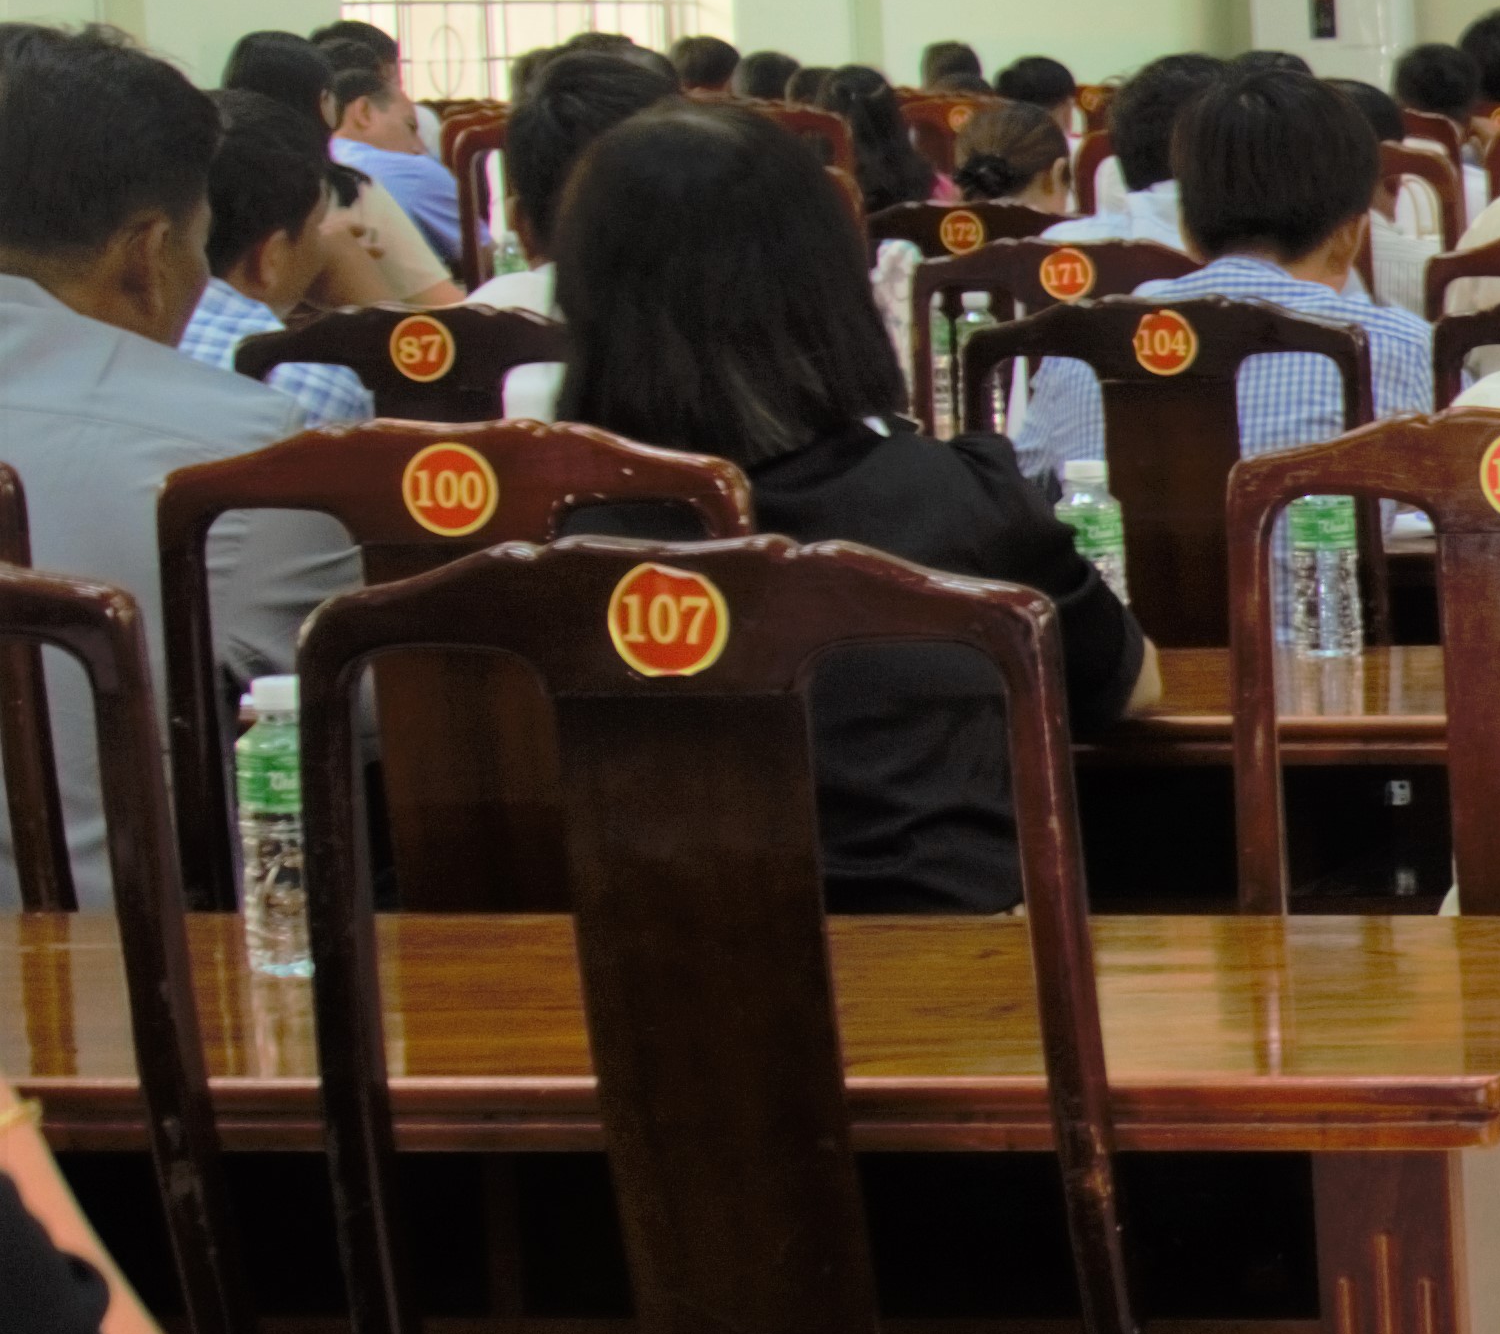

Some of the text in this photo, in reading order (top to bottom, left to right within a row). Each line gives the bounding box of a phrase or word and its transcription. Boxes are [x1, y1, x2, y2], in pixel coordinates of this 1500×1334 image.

[1045, 262, 1085, 287] 171
[398, 334, 442, 366] 87
[1139, 329, 1190, 357] 104
[413, 469, 481, 509] 100
[620, 594, 709, 646] 107
